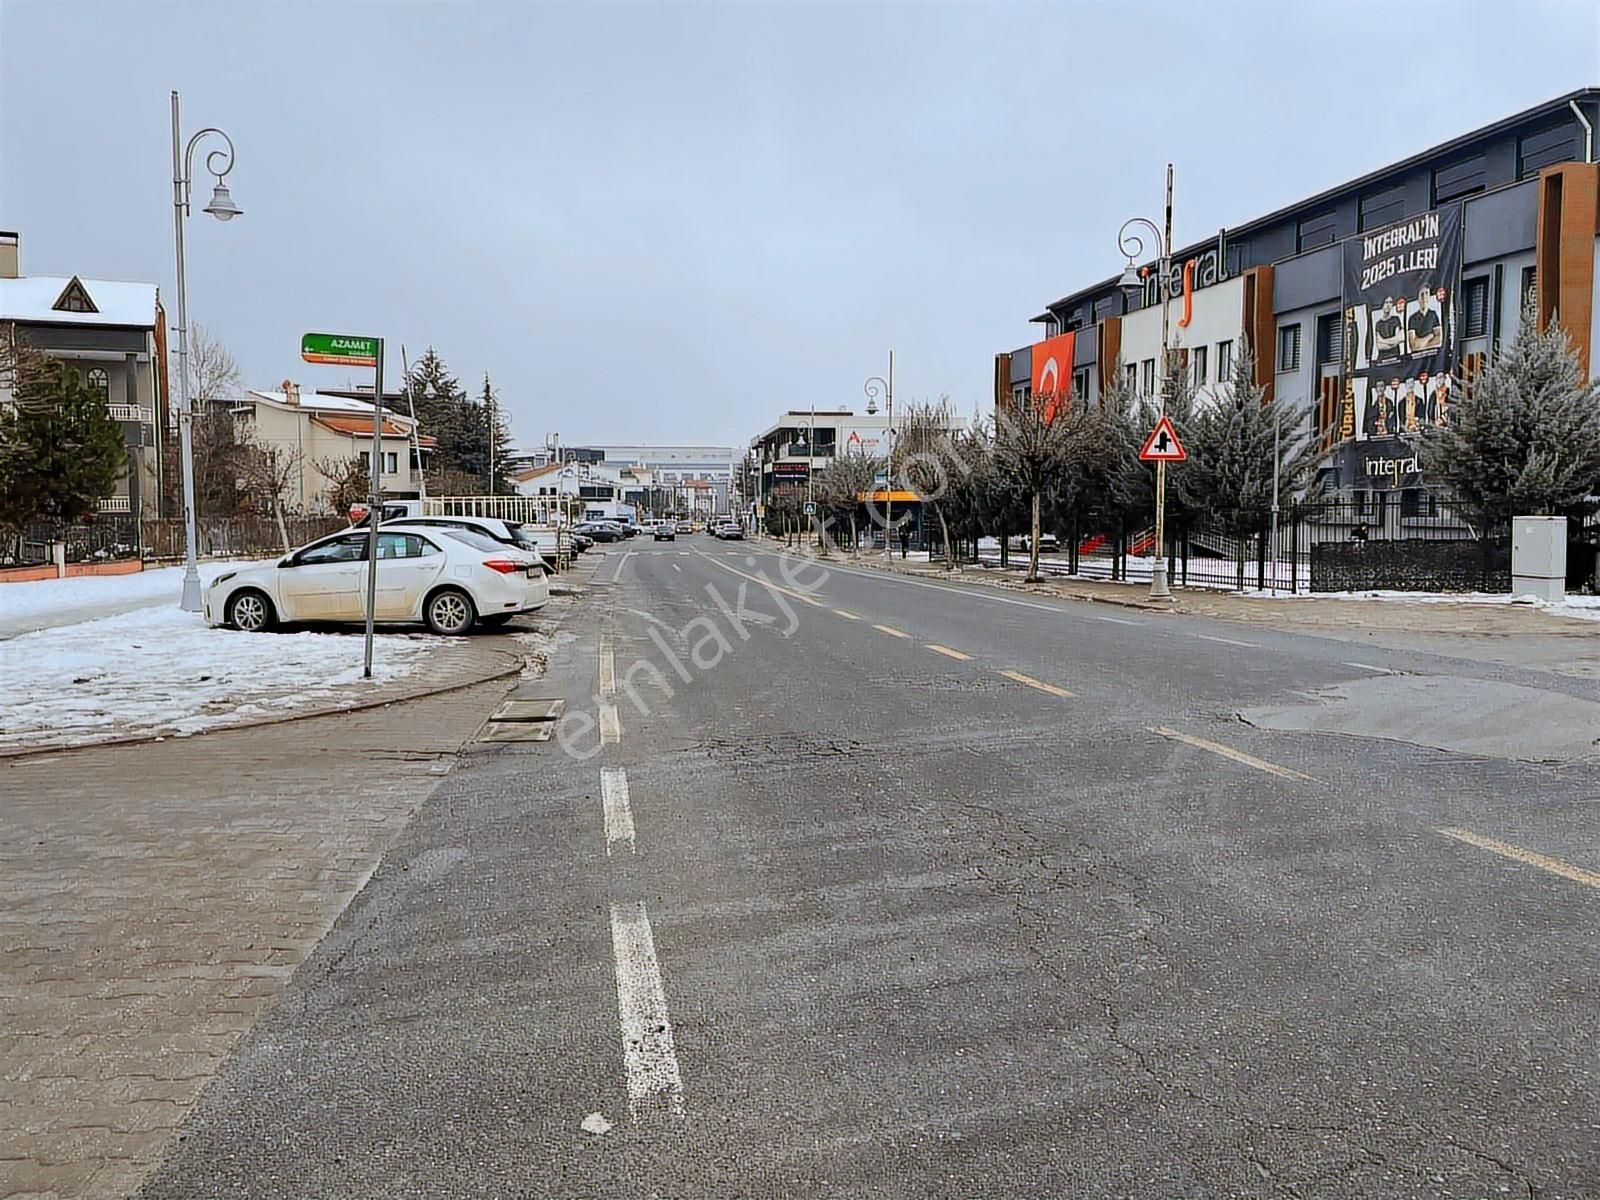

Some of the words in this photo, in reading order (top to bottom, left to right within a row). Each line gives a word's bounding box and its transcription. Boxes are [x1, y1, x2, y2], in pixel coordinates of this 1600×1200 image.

[1361, 256, 1396, 290] 2025
[1397, 243, 1439, 274] 1.LERİ
[330, 339, 371, 350] AZAMET
